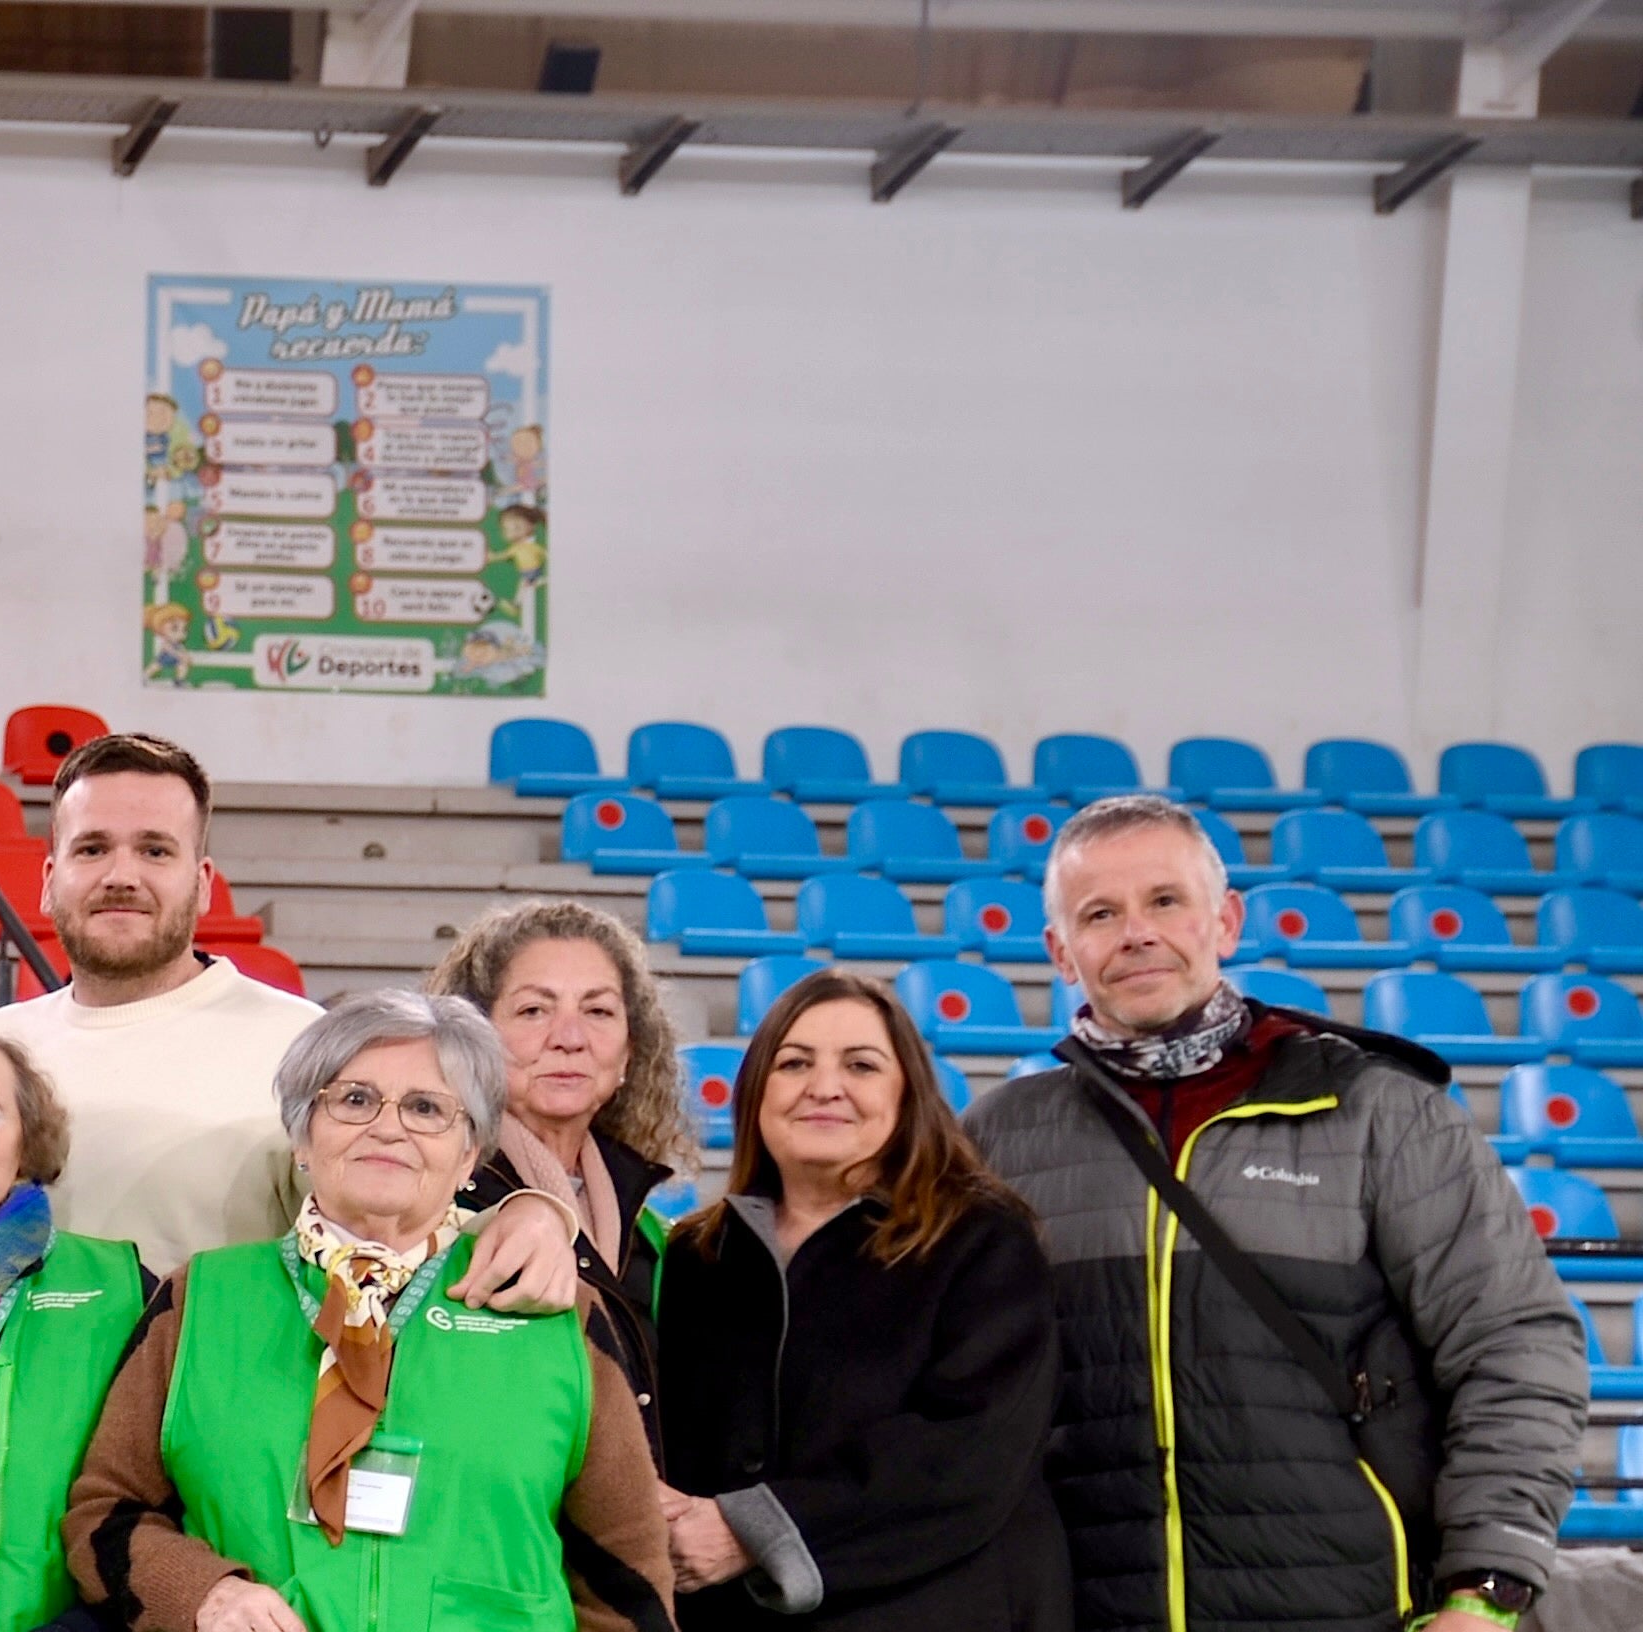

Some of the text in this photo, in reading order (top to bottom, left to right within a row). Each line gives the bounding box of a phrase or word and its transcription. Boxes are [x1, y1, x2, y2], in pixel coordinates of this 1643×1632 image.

[238, 285, 458, 335] Papá y Mamá
[363, 598, 387, 618] 10
[317, 655, 422, 678] Deportes
